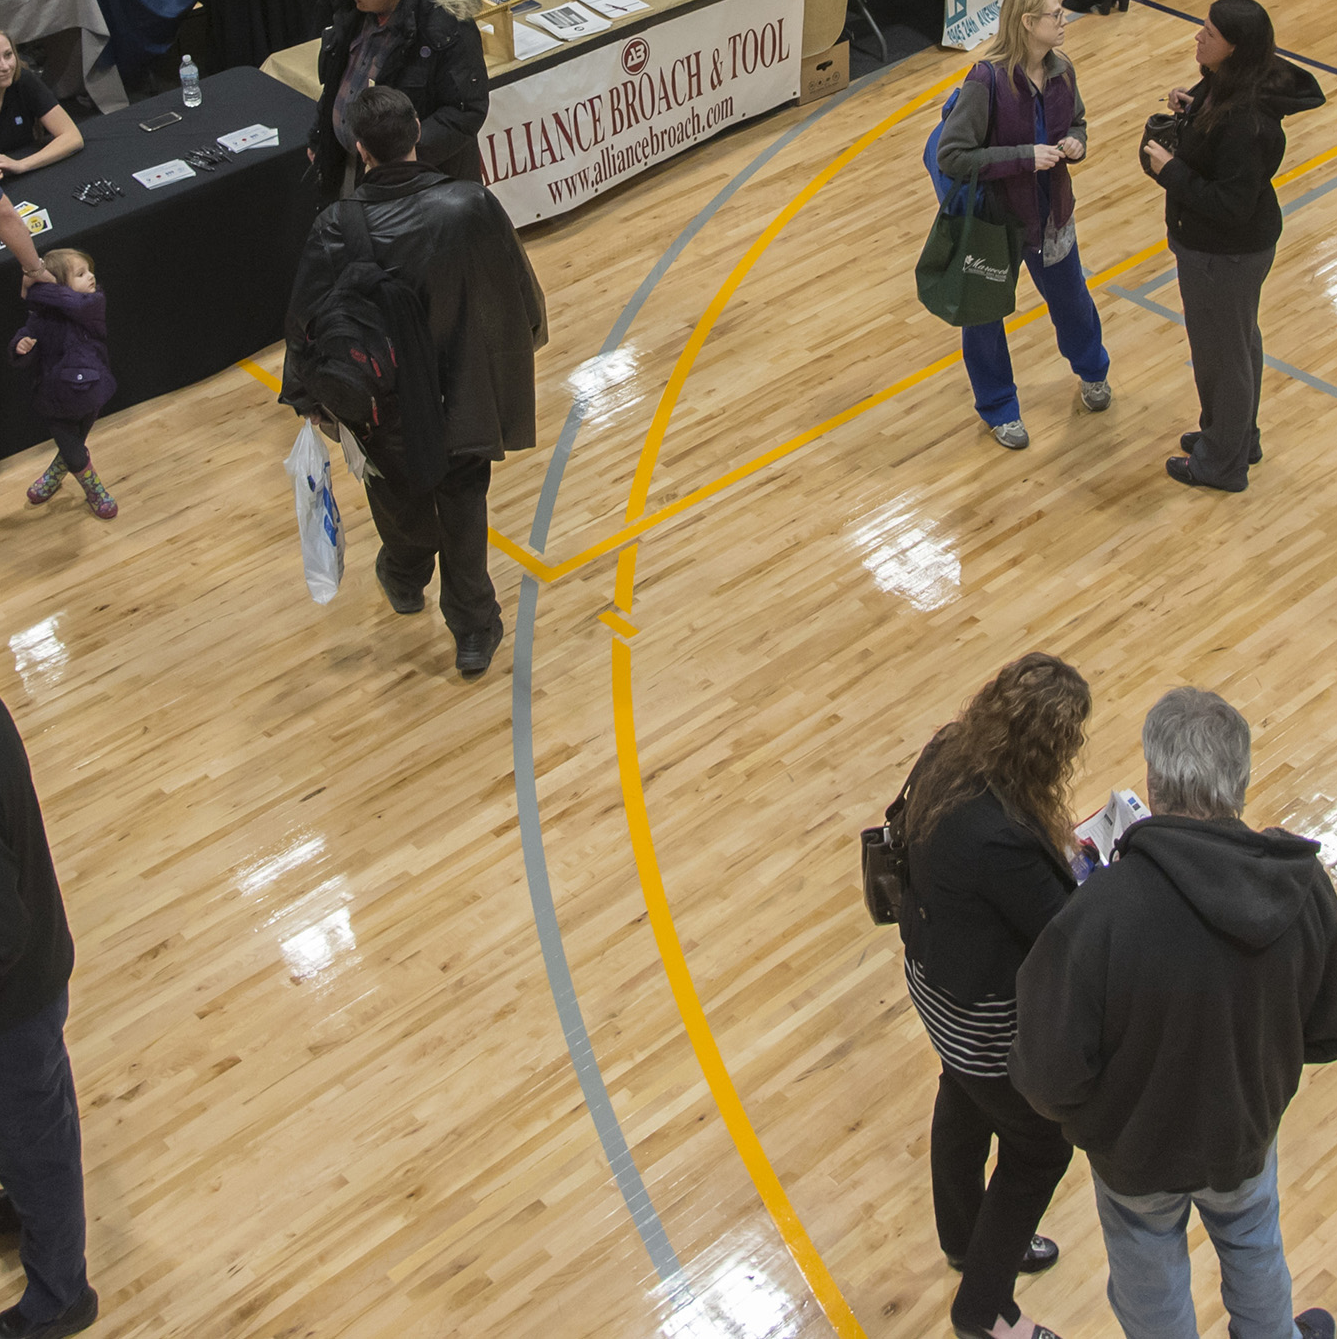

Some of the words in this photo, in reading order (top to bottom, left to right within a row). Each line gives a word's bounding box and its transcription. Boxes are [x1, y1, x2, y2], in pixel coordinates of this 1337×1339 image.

[479, 93, 605, 188] ALLIANCE
[609, 50, 703, 137] BROACH
[710, 47, 723, 91] &
[728, 17, 790, 80] TOOL
[547, 95, 734, 205] www.alliancebroach.com
